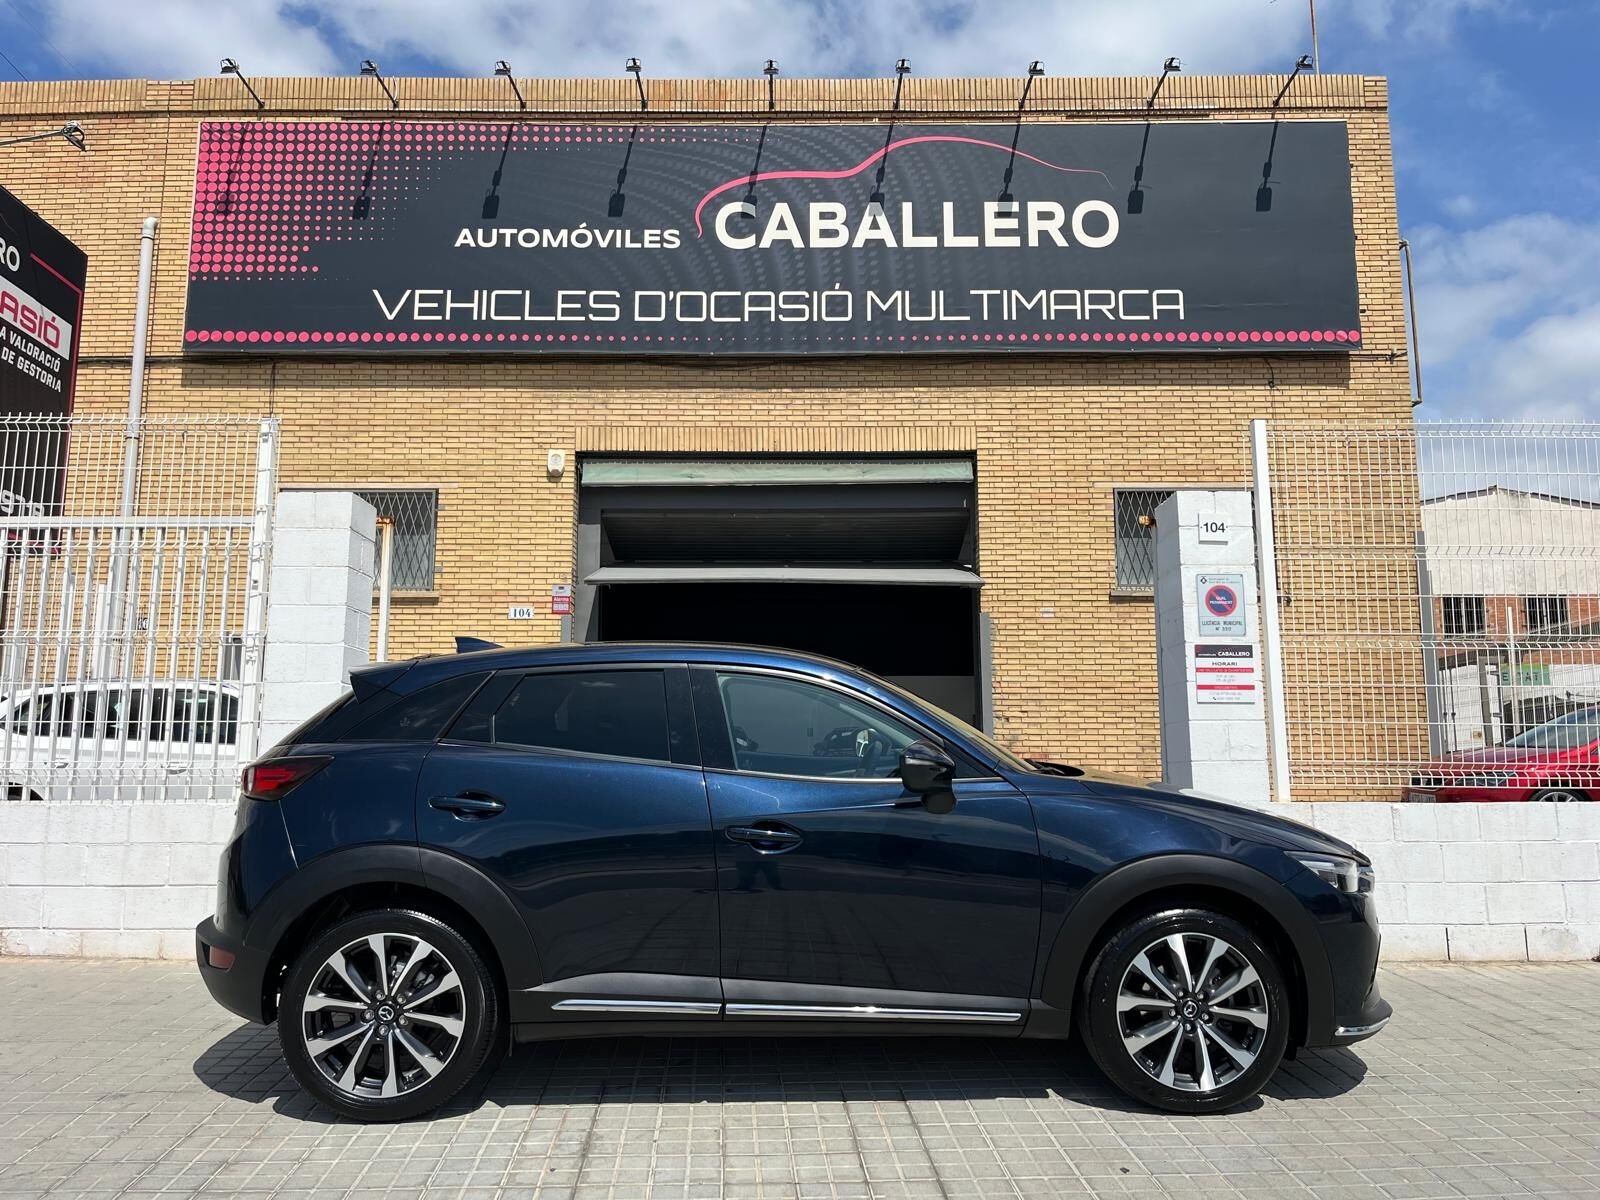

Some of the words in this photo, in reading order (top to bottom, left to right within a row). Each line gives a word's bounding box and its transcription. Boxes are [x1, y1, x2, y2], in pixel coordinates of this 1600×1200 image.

[454, 222, 681, 249] AUTOMÓVILES
[715, 201, 1119, 250] CABALLERO
[372, 289, 620, 322] VEHICLES
[634, 283, 853, 323] D'OCASIÓ
[1, 346, 16, 365] DE
[17, 356, 62, 393] GESTORIA
[10, 331, 61, 373] VALORACIÓ
[1203, 522, 1226, 533] 104
[513, 608, 531, 618] 104
